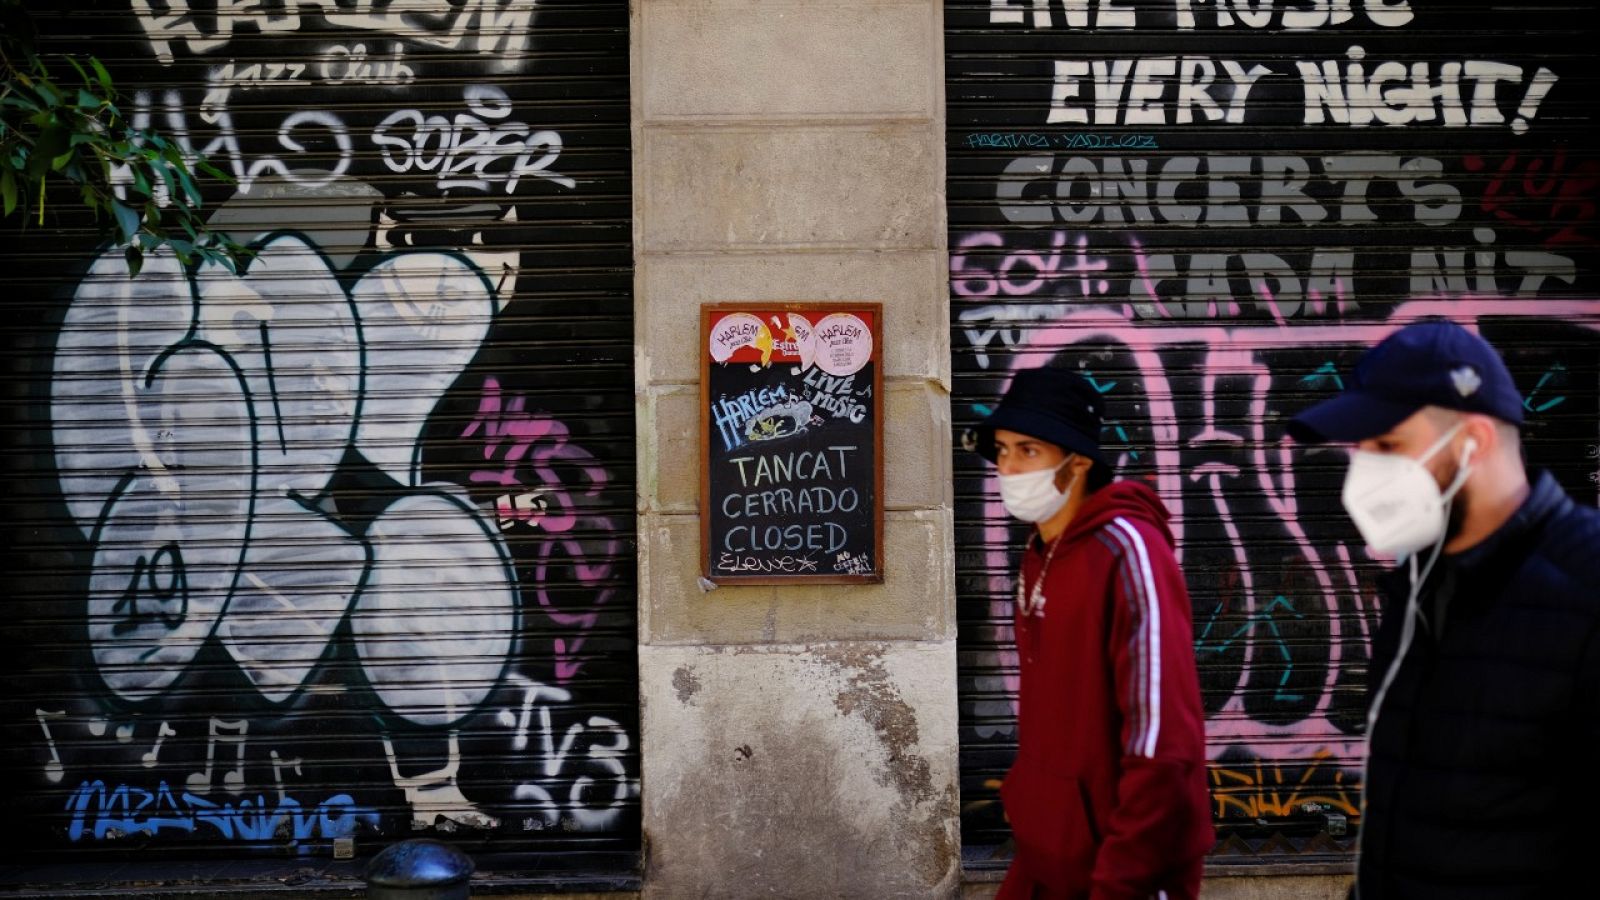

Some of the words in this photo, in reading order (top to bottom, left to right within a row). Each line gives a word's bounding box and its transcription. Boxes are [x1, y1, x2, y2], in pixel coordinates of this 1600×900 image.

[1046, 56, 1273, 125] EVERY
[996, 150, 1461, 227] CONCERTS
[1130, 245, 1359, 319] CADA
[717, 323, 758, 346] HARLEM
[819, 324, 862, 343] HARLEM
[711, 384, 786, 452] HARLEM
[729, 446, 858, 488] TANCAT
[722, 486, 859, 519] CERRADO
[724, 522, 848, 555] CLOSED
